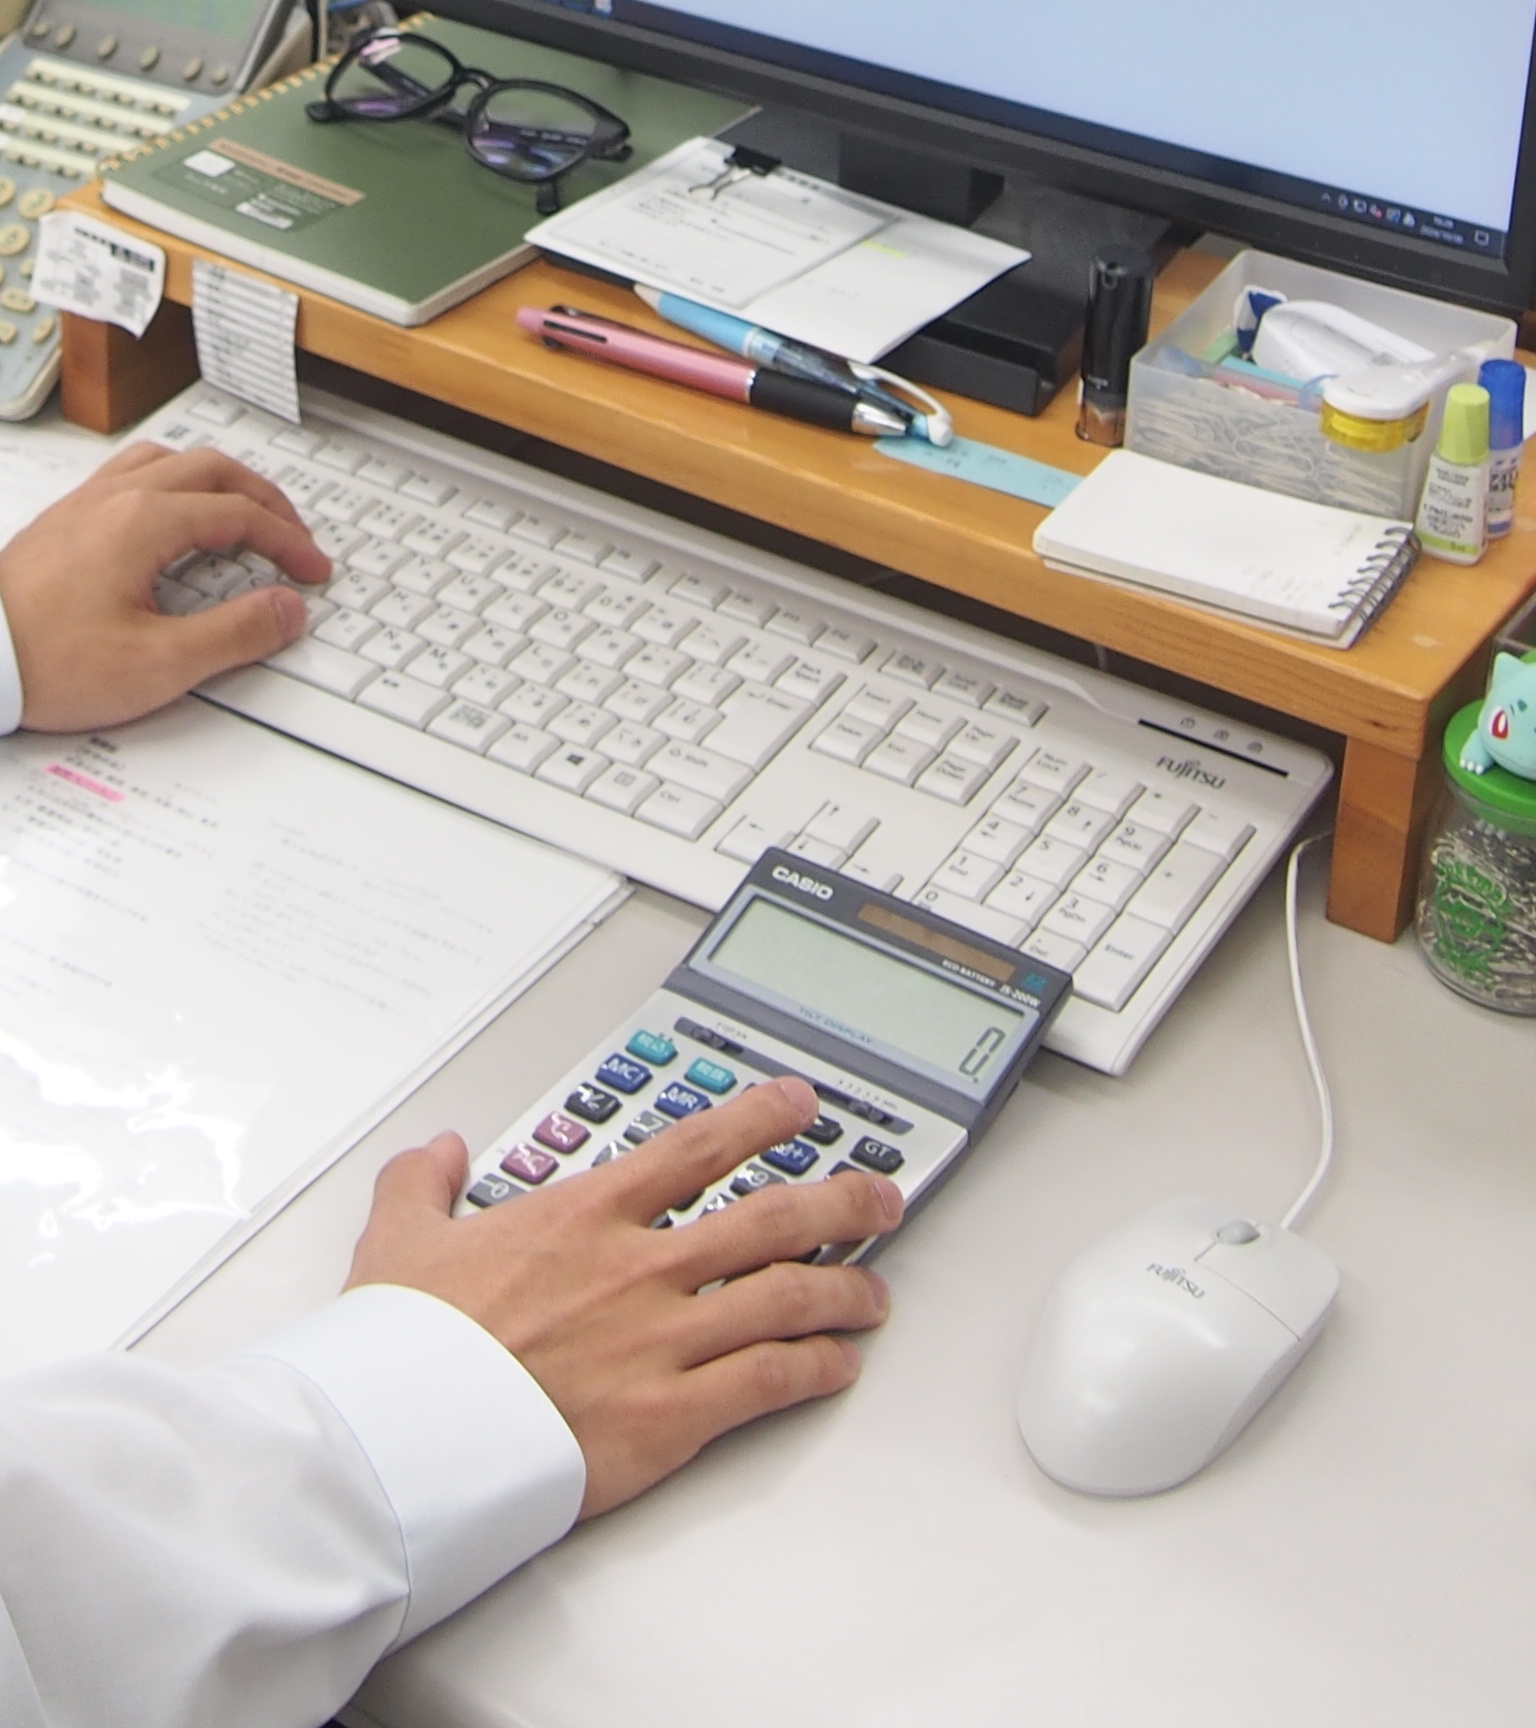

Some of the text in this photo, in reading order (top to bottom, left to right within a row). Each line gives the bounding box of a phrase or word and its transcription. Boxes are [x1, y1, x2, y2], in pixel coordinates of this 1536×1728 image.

[1156, 756, 1226, 791] FUJITSU
[772, 865, 834, 901] CASIO
[1146, 1263, 1206, 1300] FUJITSU
